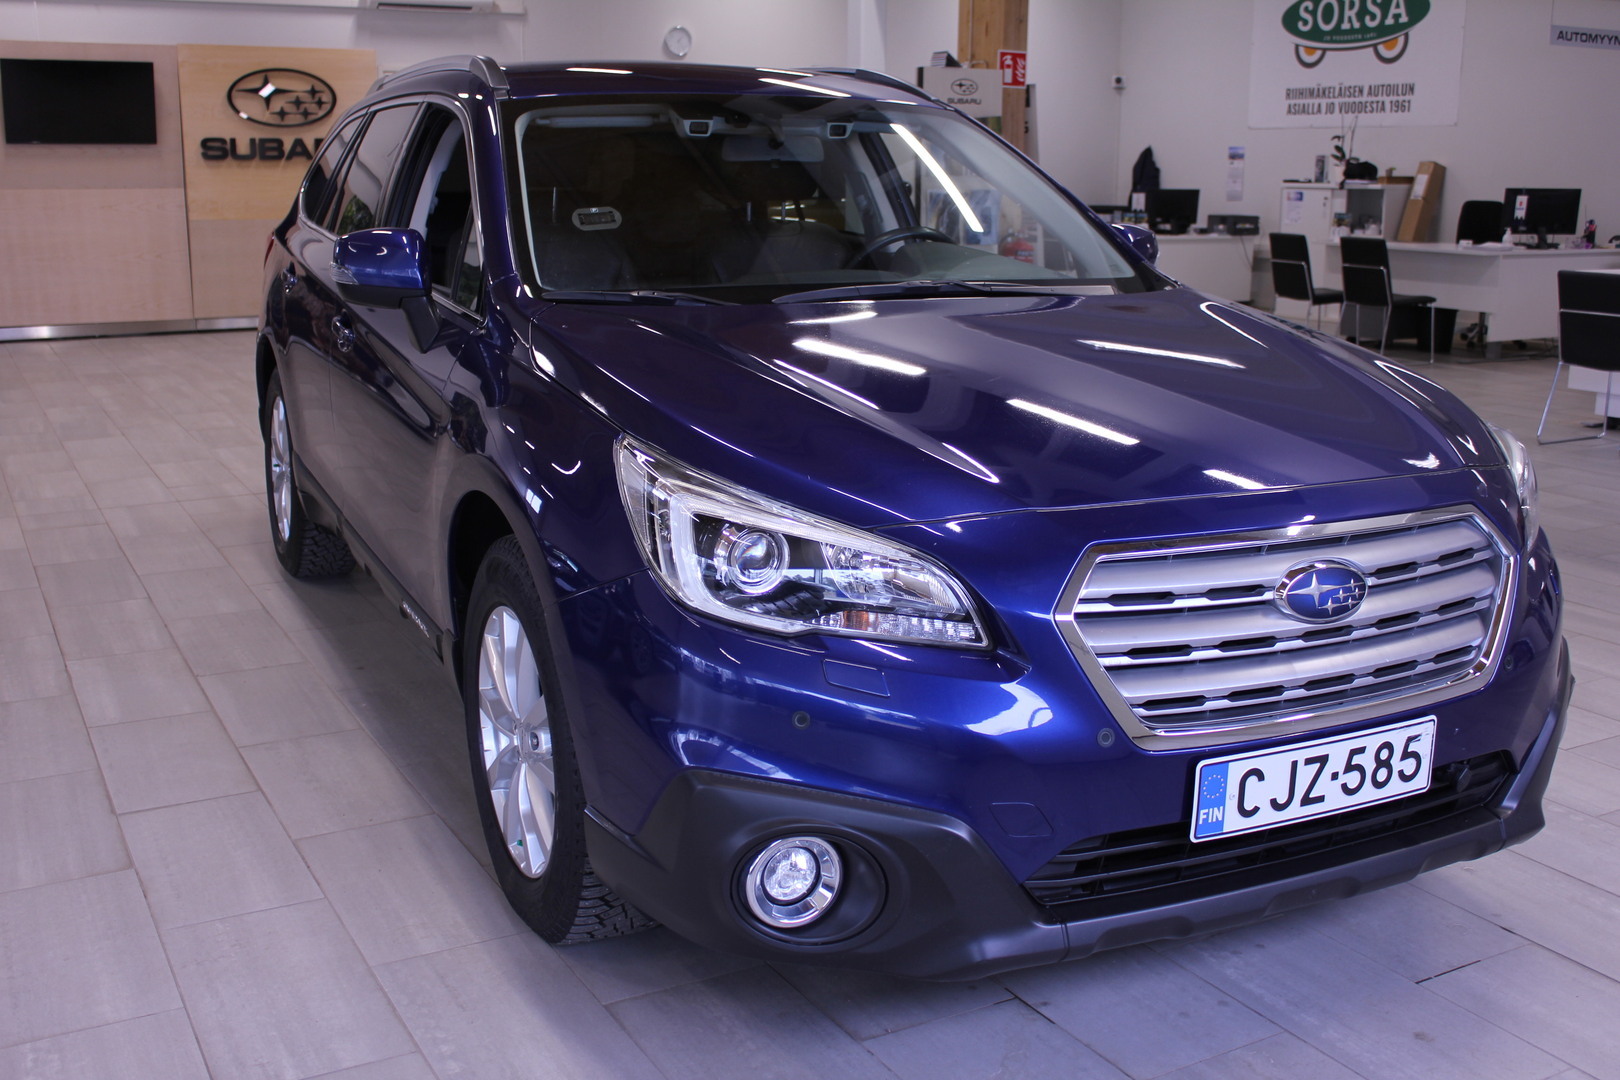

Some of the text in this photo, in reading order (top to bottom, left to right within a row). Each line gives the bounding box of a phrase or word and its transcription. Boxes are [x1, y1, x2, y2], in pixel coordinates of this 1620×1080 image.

[1297, 0, 1409, 32] SORSA
[947, 97, 982, 106] SUBARU
[1285, 83, 1415, 101] RIIHIMÄKELÄISEN AUTOILUN
[1286, 99, 1411, 116] ASIALLA JO VUODESTA 1961
[200, 137, 326, 161] SUBA
[1236, 732, 1423, 819] CJZ-585
[1198, 805, 1224, 825] FIN
